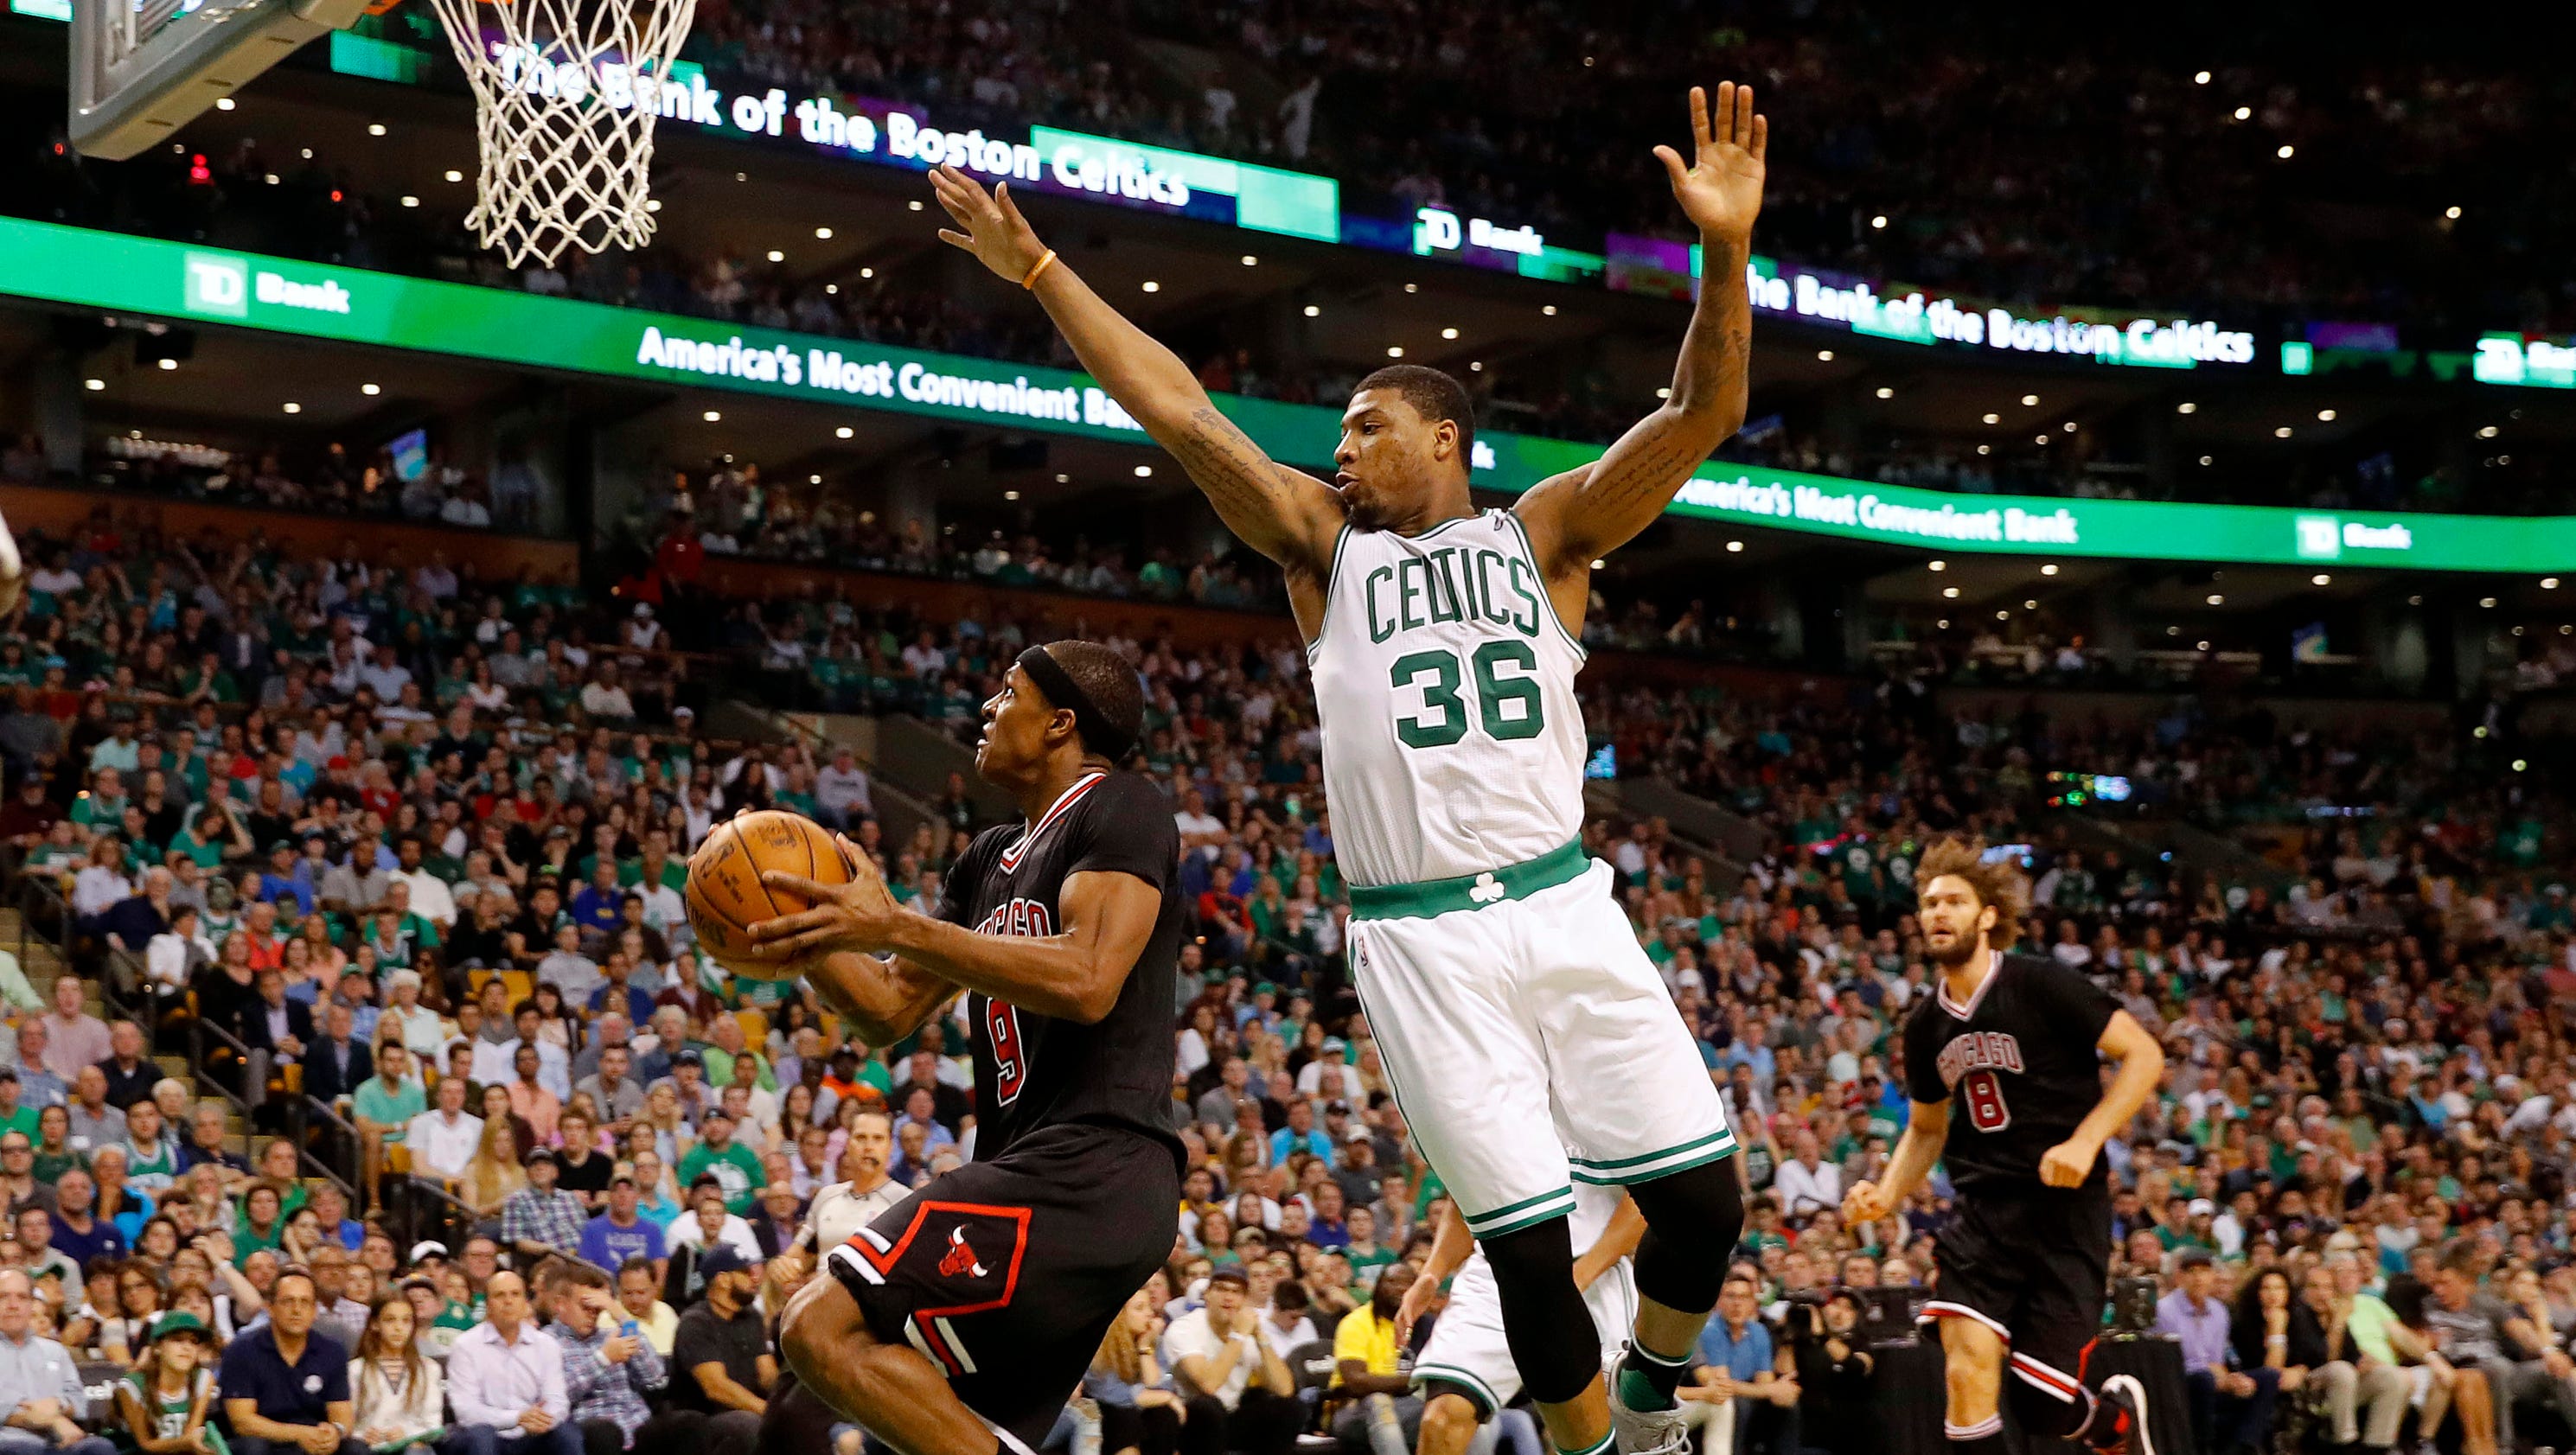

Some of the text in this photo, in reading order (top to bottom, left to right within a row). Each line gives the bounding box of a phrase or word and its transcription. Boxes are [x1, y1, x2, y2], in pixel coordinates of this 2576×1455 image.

[490, 41, 1190, 207] The Bank of the Boston Celtics
[1416, 207, 1544, 256] TD Bank
[190, 262, 350, 315] TD Bank
[1746, 263, 2254, 363] he Bank of the Boston Celtics
[637, 326, 802, 386] America's
[809, 348, 894, 399] Most
[898, 362, 1079, 423] Convenient
[1793, 485, 1857, 526] Most
[1859, 495, 2004, 542] Convenient
[2004, 507, 2080, 544] Bank
[2343, 522, 2413, 550] Bank
[1366, 547, 1539, 644] CELTICS
[1390, 640, 1545, 750] 36
[986, 996, 1026, 1107] 9
[1964, 1069, 2011, 1133] 8
